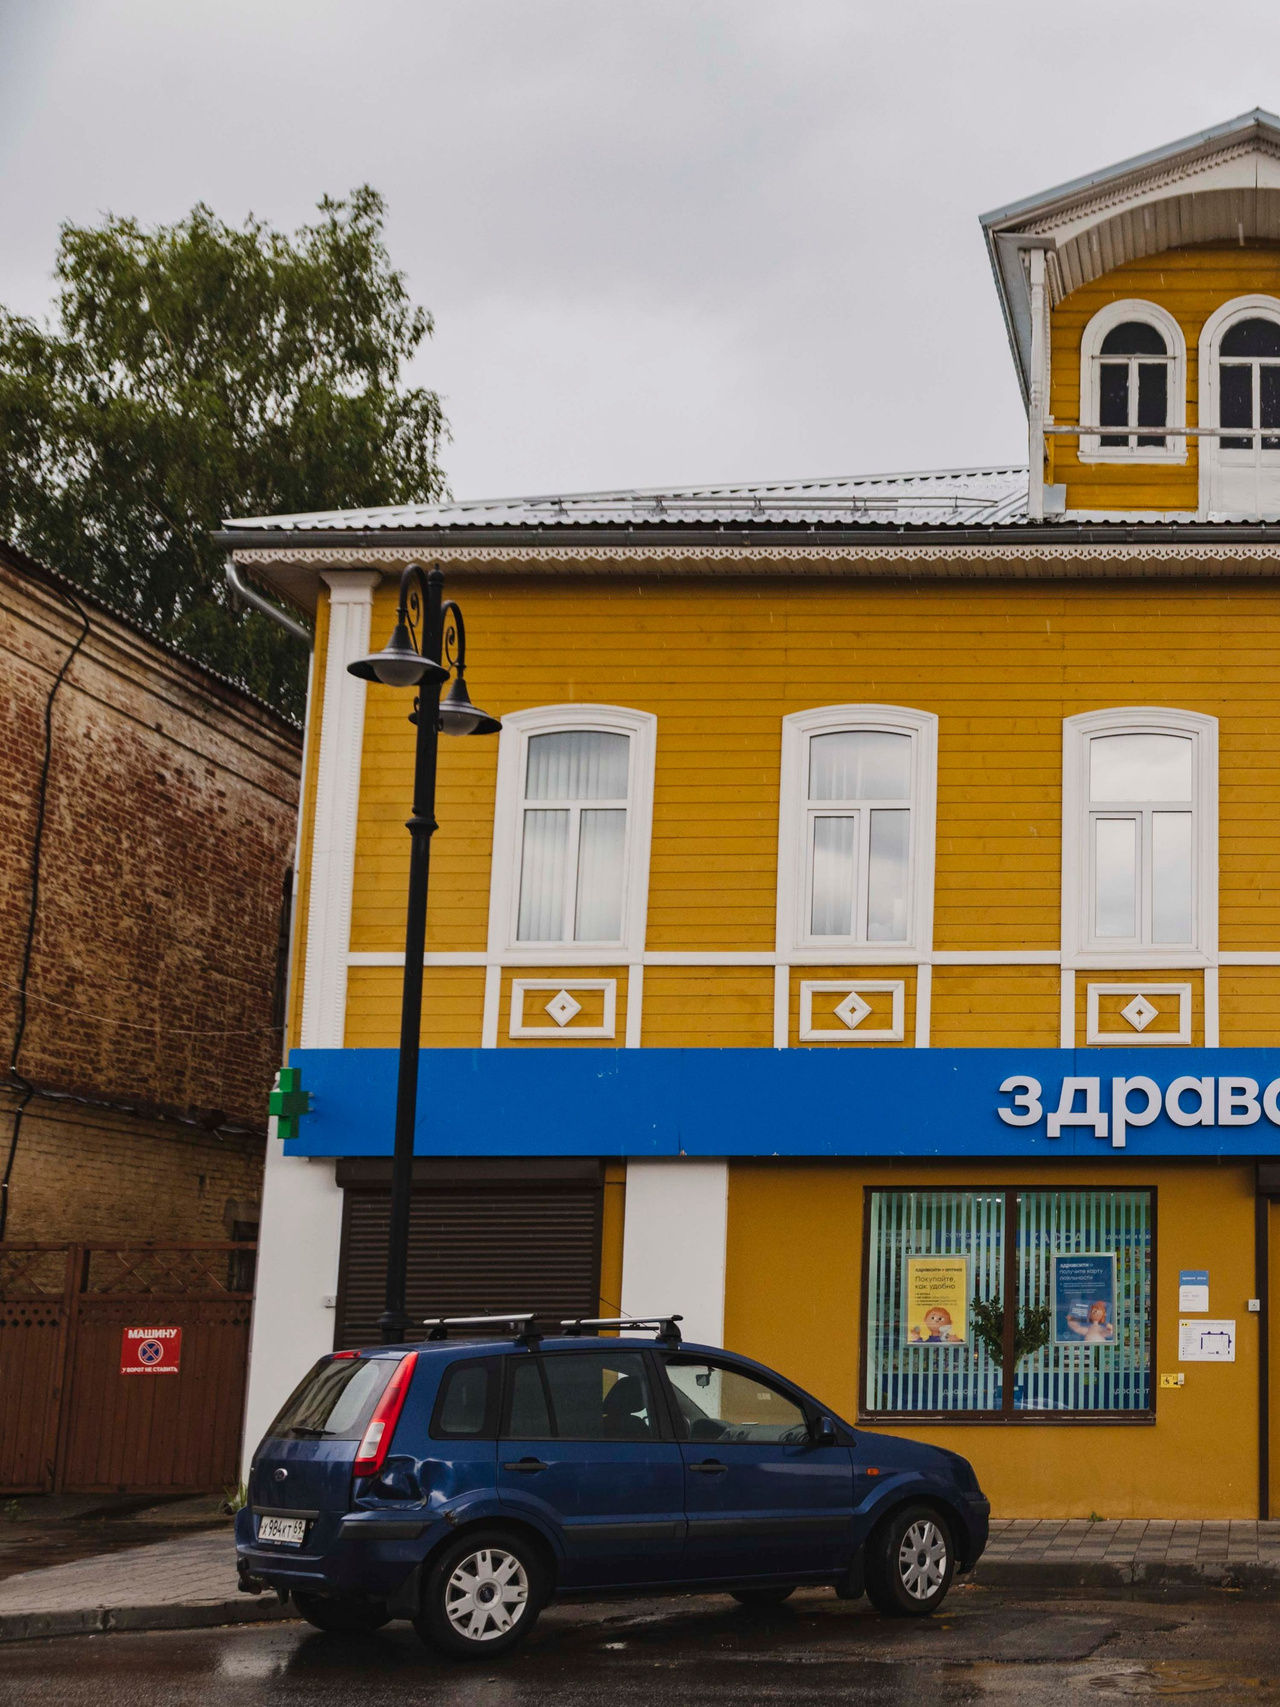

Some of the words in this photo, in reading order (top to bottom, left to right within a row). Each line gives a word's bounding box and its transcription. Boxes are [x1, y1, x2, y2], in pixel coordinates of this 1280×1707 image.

[915, 1275, 956, 1283] Покупайте,
[929, 1283, 956, 1291] удобно
[128, 1329, 178, 1339] МАШИНУ
